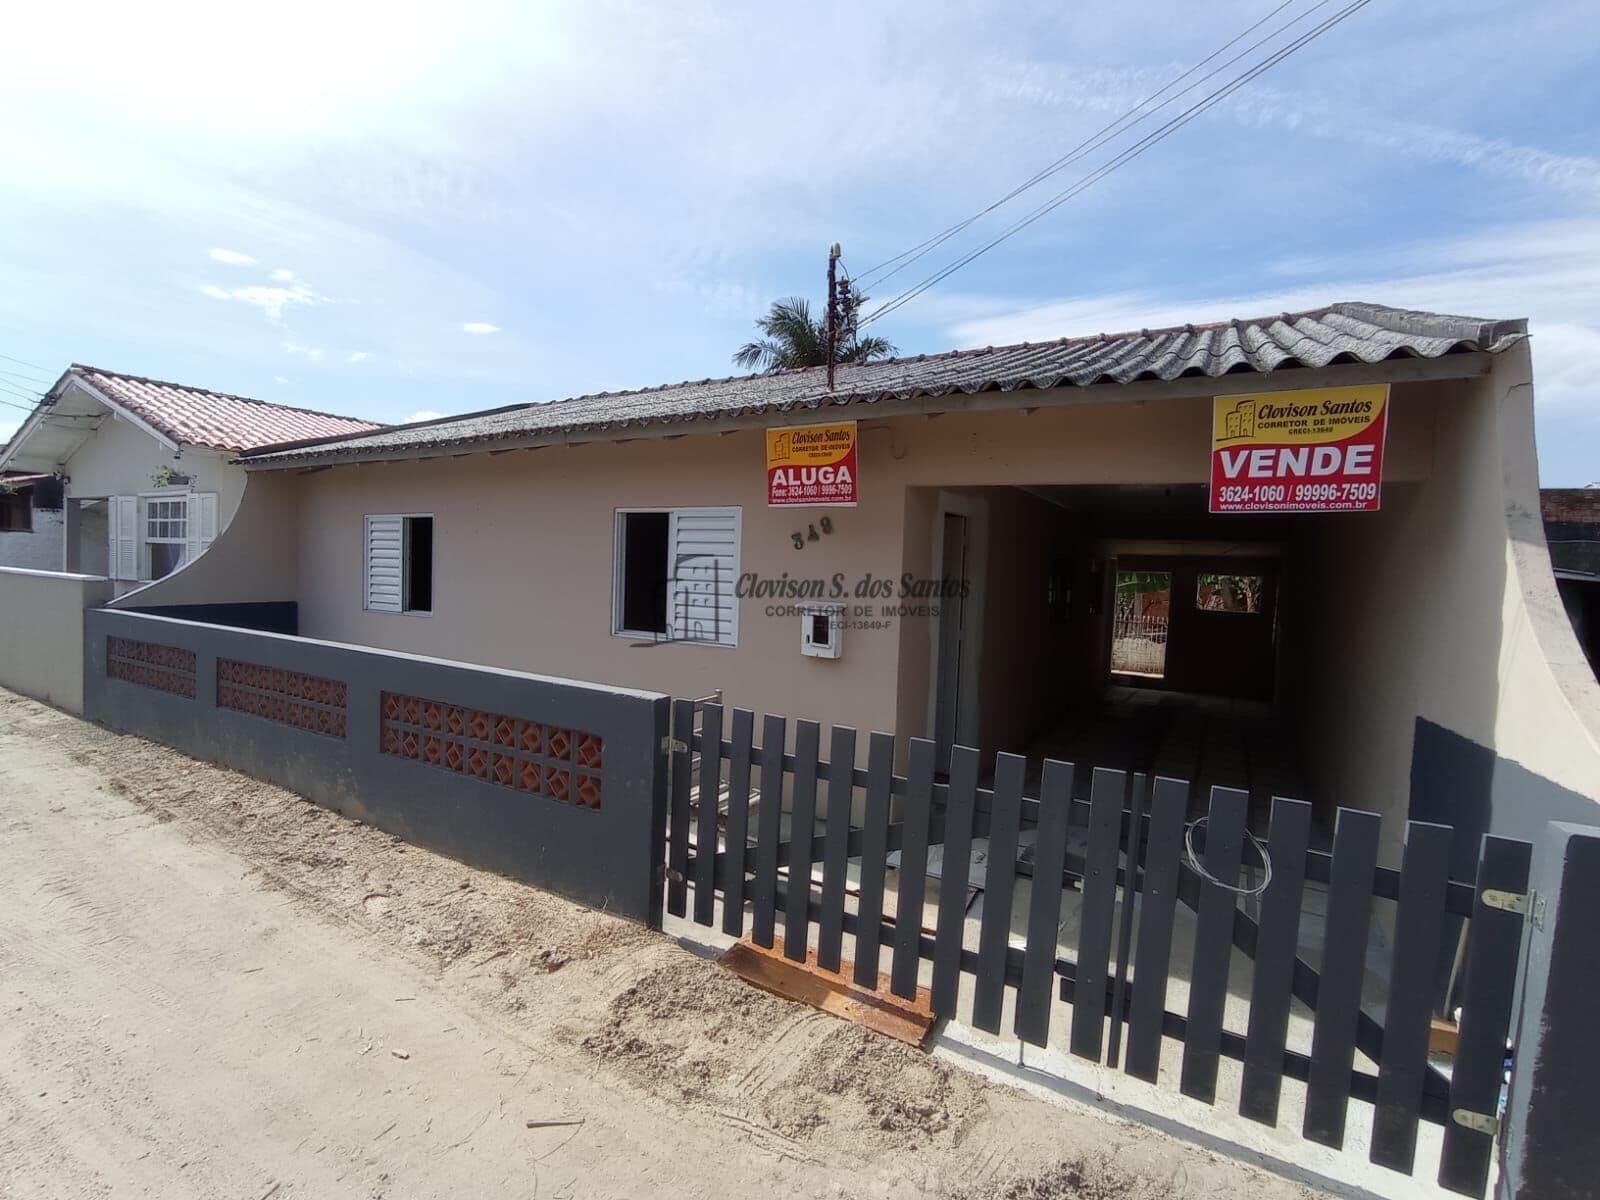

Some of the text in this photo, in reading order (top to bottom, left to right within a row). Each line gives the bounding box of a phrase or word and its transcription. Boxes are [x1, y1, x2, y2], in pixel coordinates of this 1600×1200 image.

[1258, 400, 1373, 419] Clovison Santos
[1257, 414, 1371, 430] CORRETOR DE IMÓVEIS
[792, 429, 850, 445] Clovison Santos
[1220, 445, 1375, 479] VENDE
[772, 465, 852, 487] ALUGA
[1219, 485, 1284, 502] 3624-1060
[1295, 483, 1377, 501] 99996-7509
[1219, 501, 1368, 511] www.clovisonimoveis.com.br
